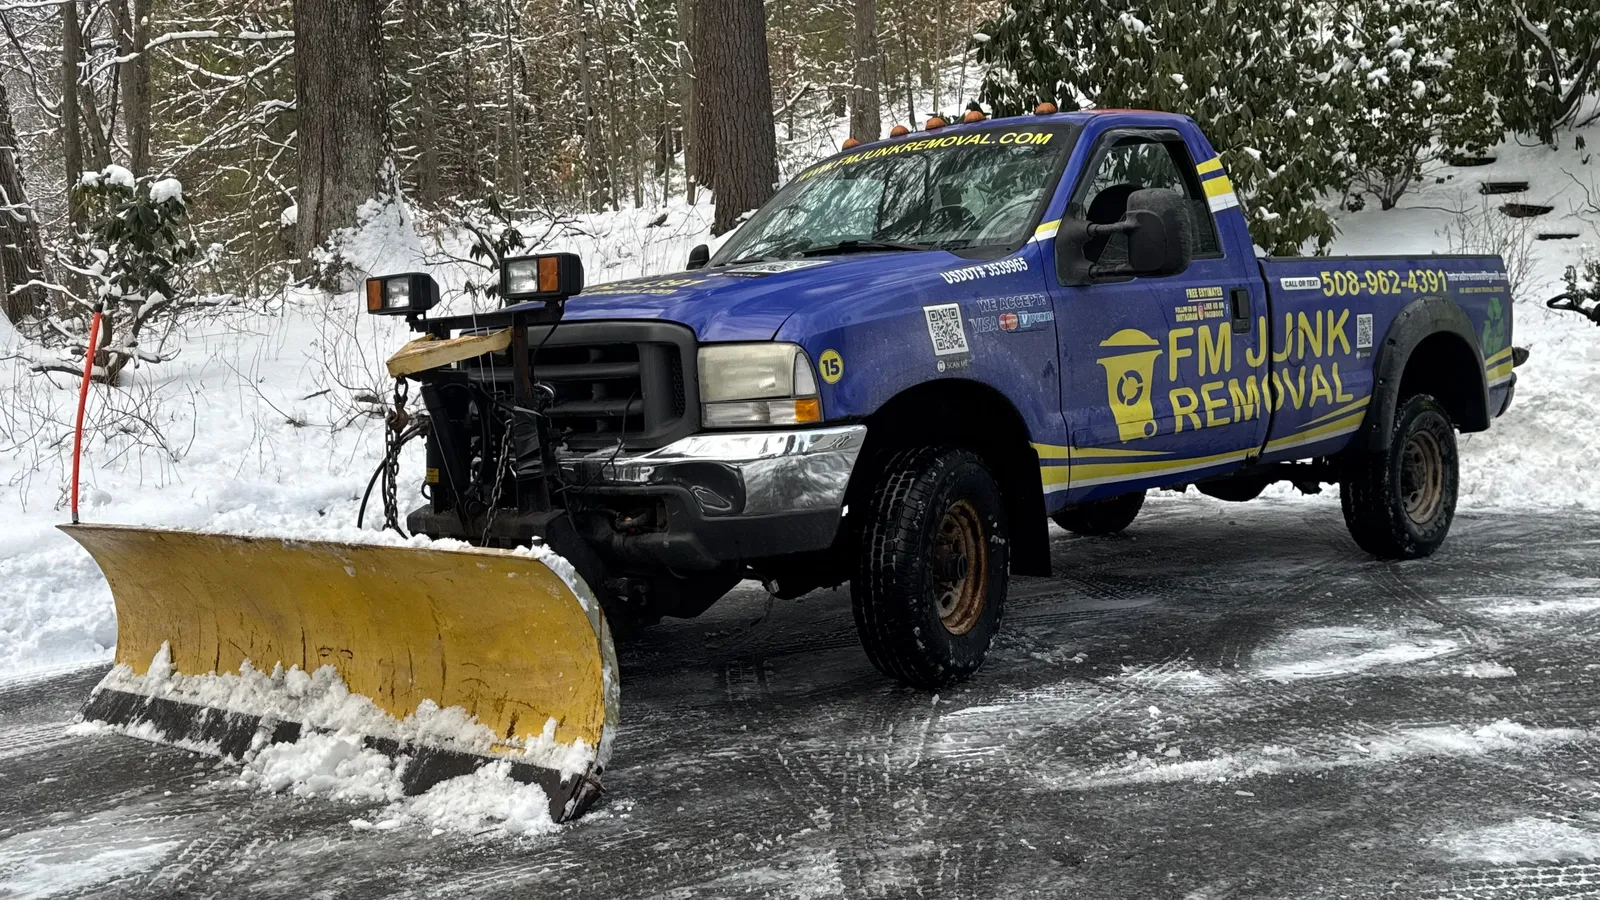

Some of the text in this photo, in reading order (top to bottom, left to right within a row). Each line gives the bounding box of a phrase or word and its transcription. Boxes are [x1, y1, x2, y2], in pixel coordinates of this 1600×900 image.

[940, 257, 1028, 284] USDOT# 3539965
[1285, 280, 1298, 288] CALL
[1306, 279, 1319, 287] TEXT
[1320, 268, 1448, 297] 508-962-4391
[977, 293, 1046, 313] WE ACCEPT:
[969, 316, 998, 333] VISA
[1168, 308, 1351, 382] FM JUNK
[822, 358, 840, 377] 15
[1169, 362, 1354, 434] REMOVAL
